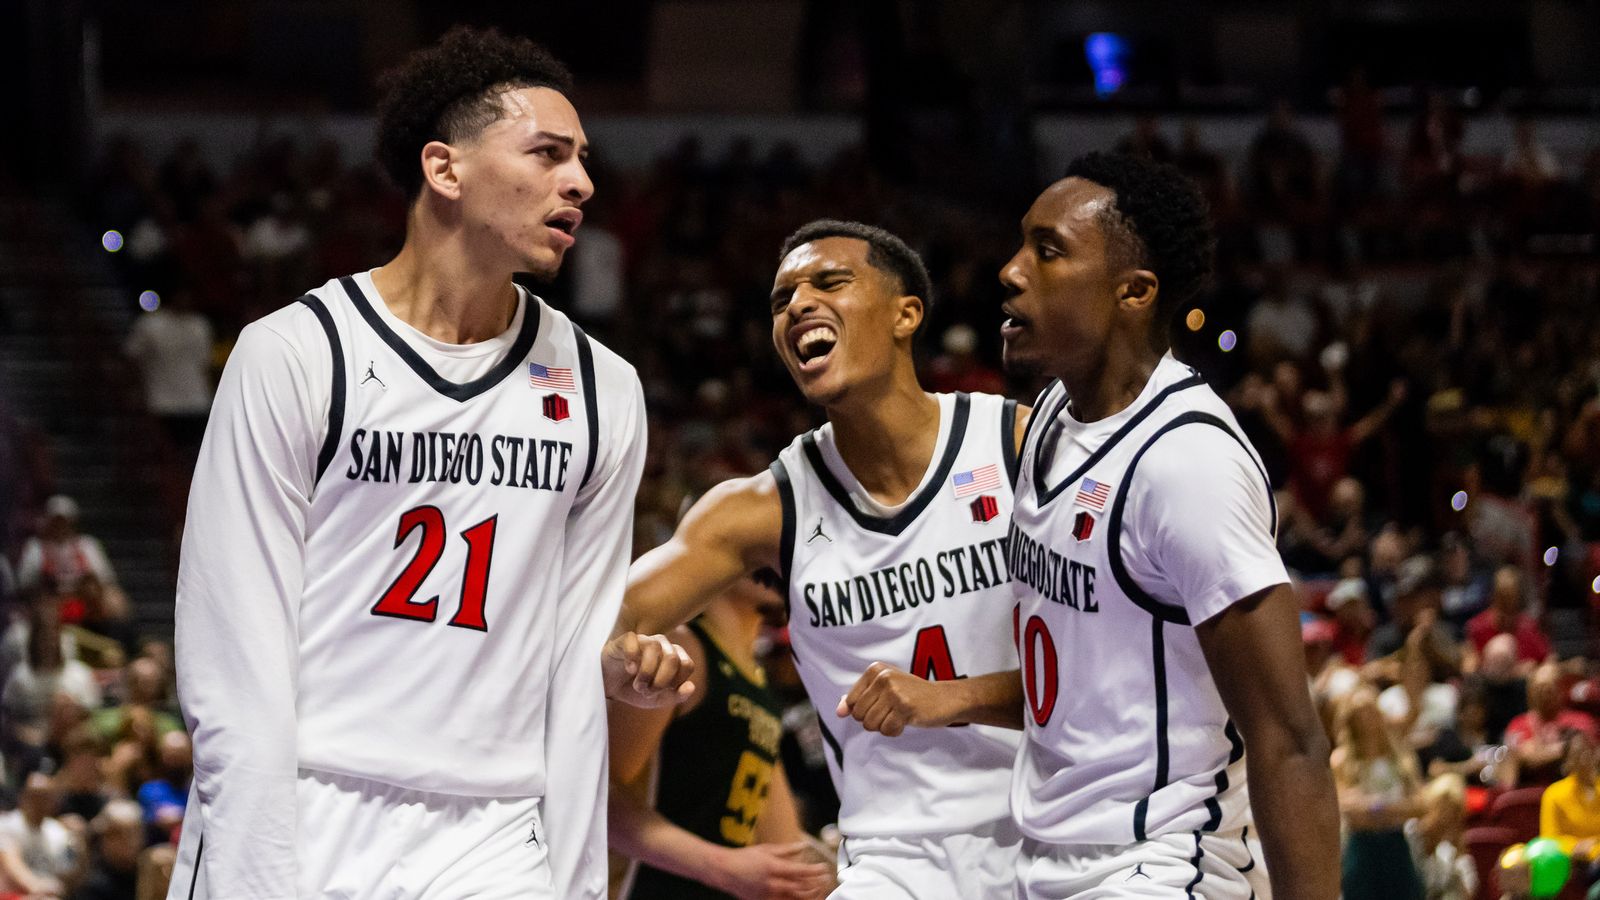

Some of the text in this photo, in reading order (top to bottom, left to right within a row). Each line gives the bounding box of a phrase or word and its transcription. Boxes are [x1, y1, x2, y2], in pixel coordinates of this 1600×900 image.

[346, 428, 573, 493] SAN DIEGO STATE
[370, 504, 498, 633] 21
[803, 580, 854, 628] SAN
[853, 557, 936, 623] DIEGO
[1043, 547, 1100, 614] STATE
